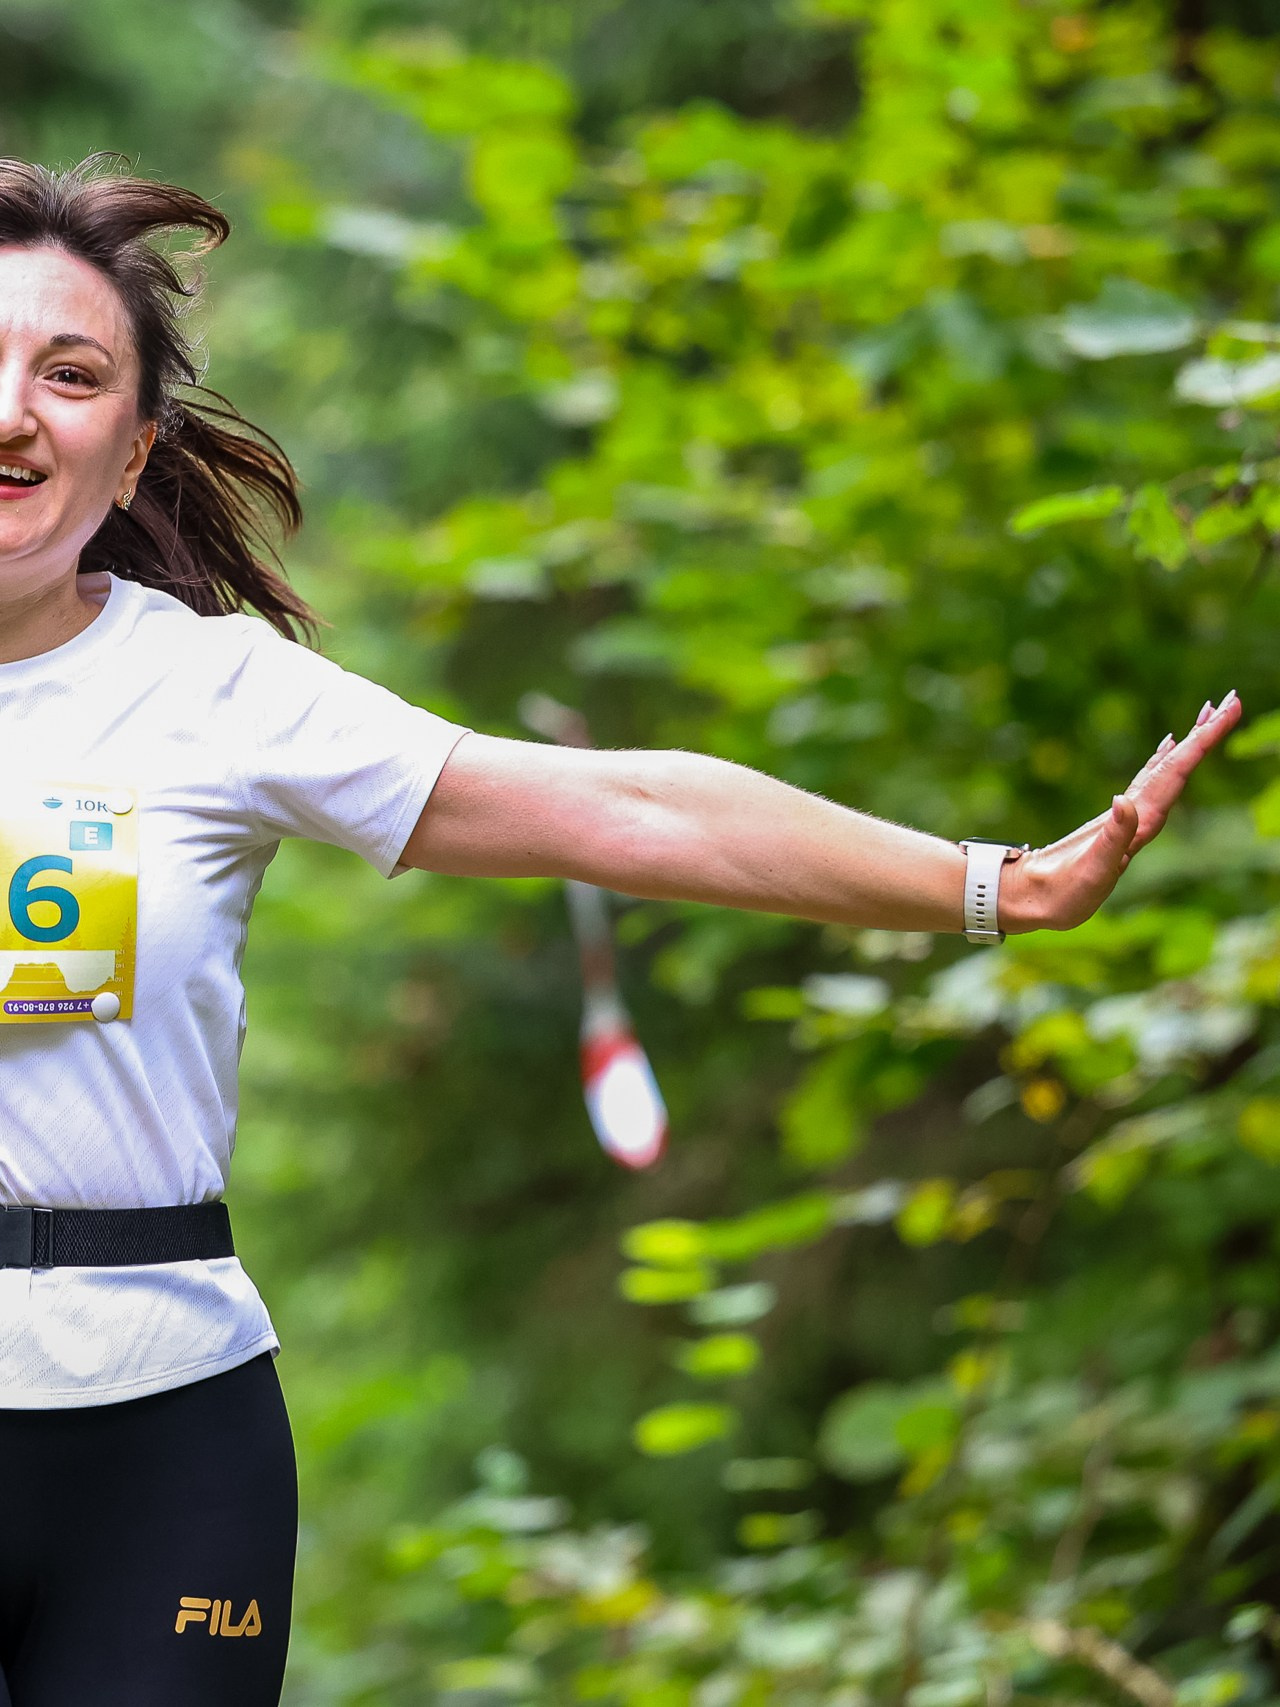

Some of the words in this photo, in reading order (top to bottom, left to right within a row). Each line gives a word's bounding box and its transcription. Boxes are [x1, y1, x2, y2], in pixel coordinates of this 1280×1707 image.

[84, 826, 99, 845] E
[7, 1002, 55, 1012] 878-80-91
[58, 1002, 74, 1011] 926
[77, 1001, 90, 1010] +7
[175, 1596, 262, 1637] FILA
